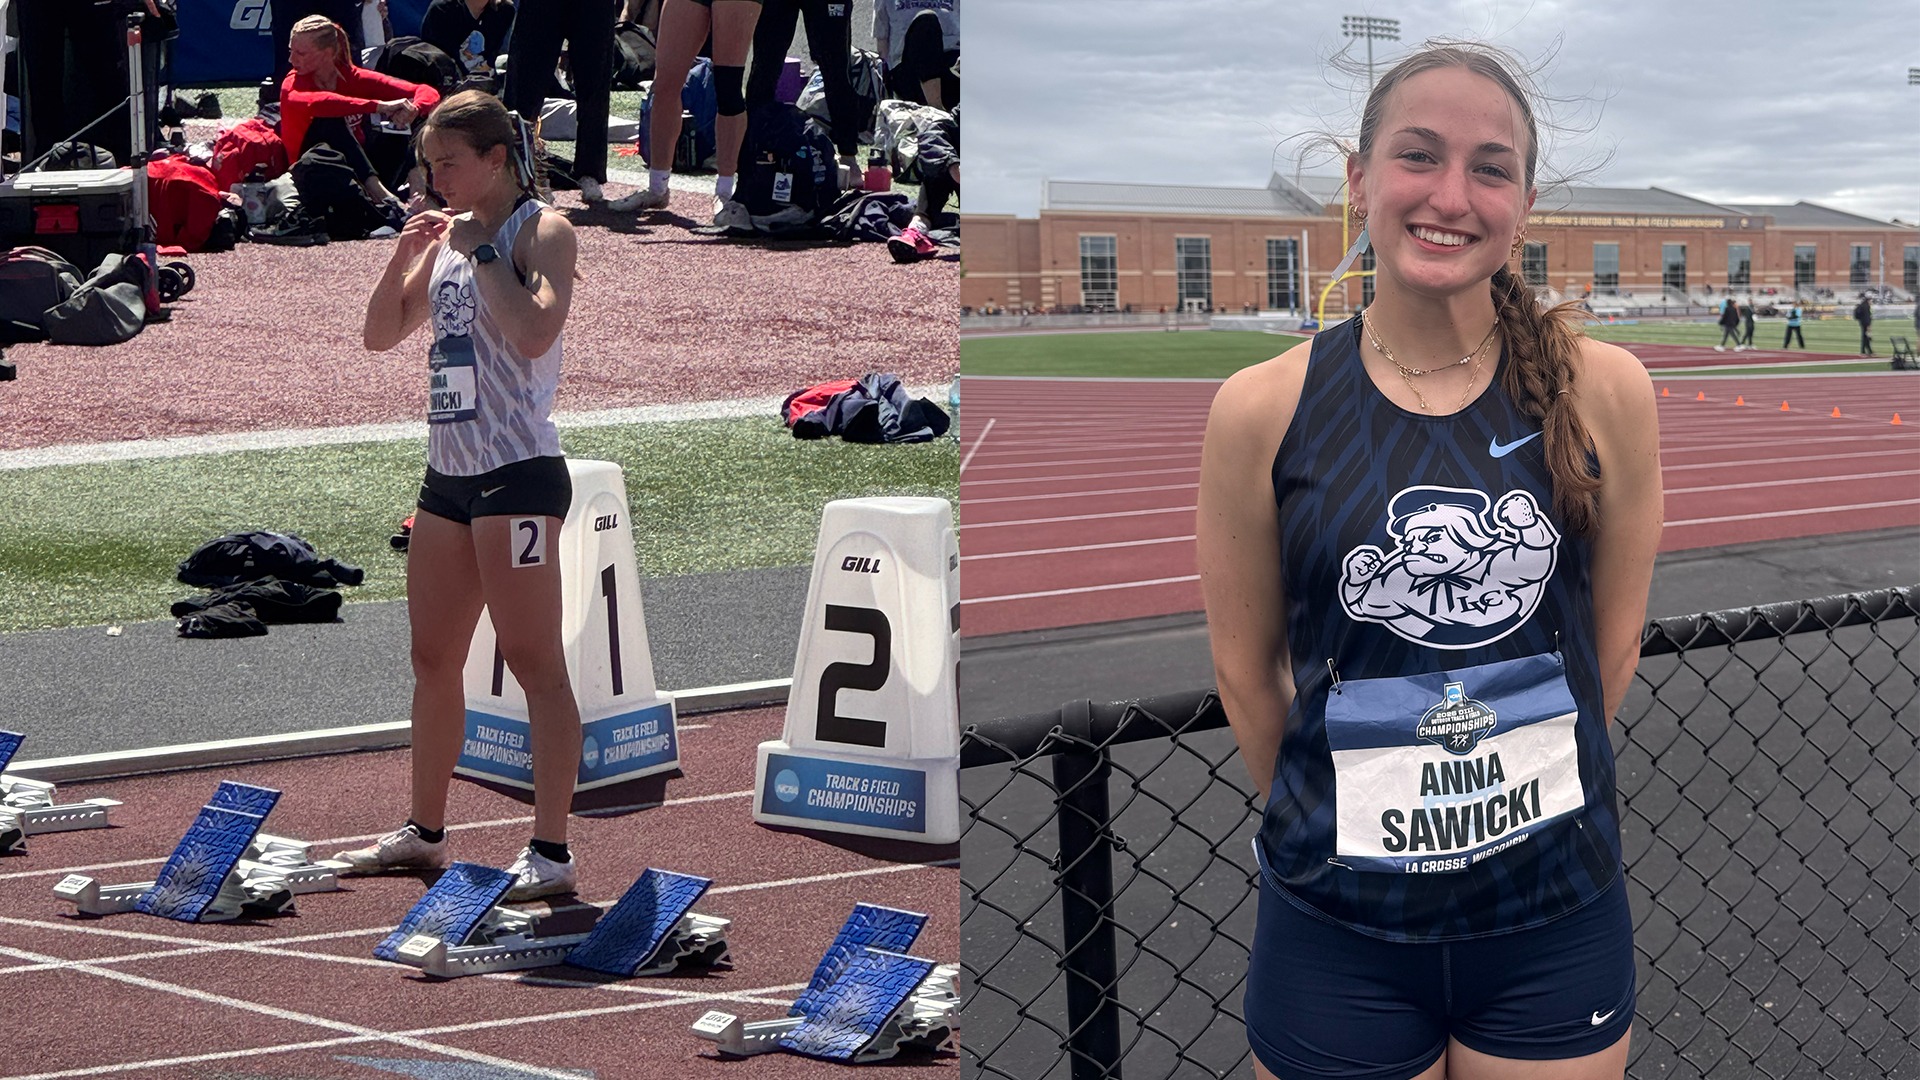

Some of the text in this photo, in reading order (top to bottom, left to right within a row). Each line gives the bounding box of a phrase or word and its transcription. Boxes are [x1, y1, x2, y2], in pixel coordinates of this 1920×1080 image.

[229, 0, 272, 29] GI
[594, 513, 619, 532] GILL
[518, 520, 540, 565] 2
[840, 556, 881, 573] GILL
[1457, 590, 1504, 615] LVC
[601, 563, 624, 696] 1
[815, 603, 892, 748] 2
[1419, 714, 1495, 737] CHAMPIONSHIPS
[604, 733, 670, 766] CHAMPIONSHIPS
[826, 773, 860, 792] TRACK
[869, 779, 900, 797] FIELD
[1419, 752, 1506, 797] ANNA
[807, 788, 917, 818] CHAMPIONSHIPS
[1381, 777, 1543, 853] SAWICKI
[1405, 862, 1418, 873] LA
[1421, 857, 1468, 873] CROSSE
